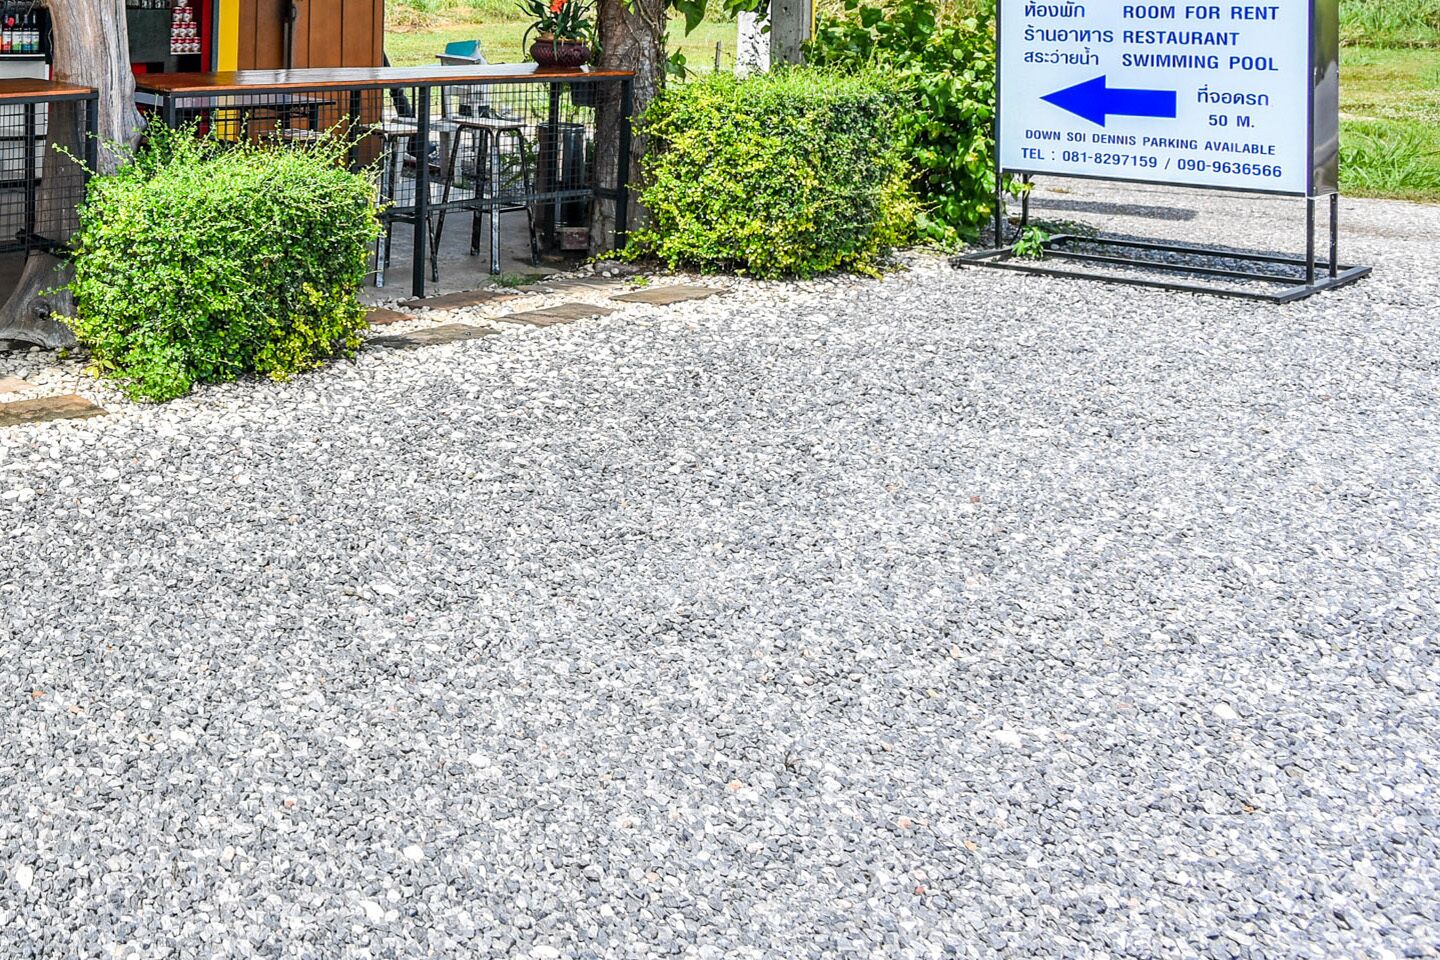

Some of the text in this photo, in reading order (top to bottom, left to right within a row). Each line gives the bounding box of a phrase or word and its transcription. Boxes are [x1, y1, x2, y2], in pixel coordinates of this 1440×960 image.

[1024, 0, 1086, 18] ห้องพัก
[1122, 5, 1280, 21] ROOM FOR RENT
[1024, 24, 1114, 44] ร้านอาหาร
[1123, 30, 1241, 46] RESTAURANT
[1023, 46, 1099, 66] สระว่ายน้ำ
[1122, 52, 1279, 71] SWIMMING POOL
[1197, 84, 1269, 106] ที่จอดรถ
[1208, 114, 1255, 128] 50 M.
[1025, 129, 1276, 156] DOWN SOI DENNIS PARKING AVAILABLE
[1020, 147, 1045, 161] TEL
[1062, 150, 1158, 168] 081-8297159
[1177, 158, 1282, 178] 090-9636566
